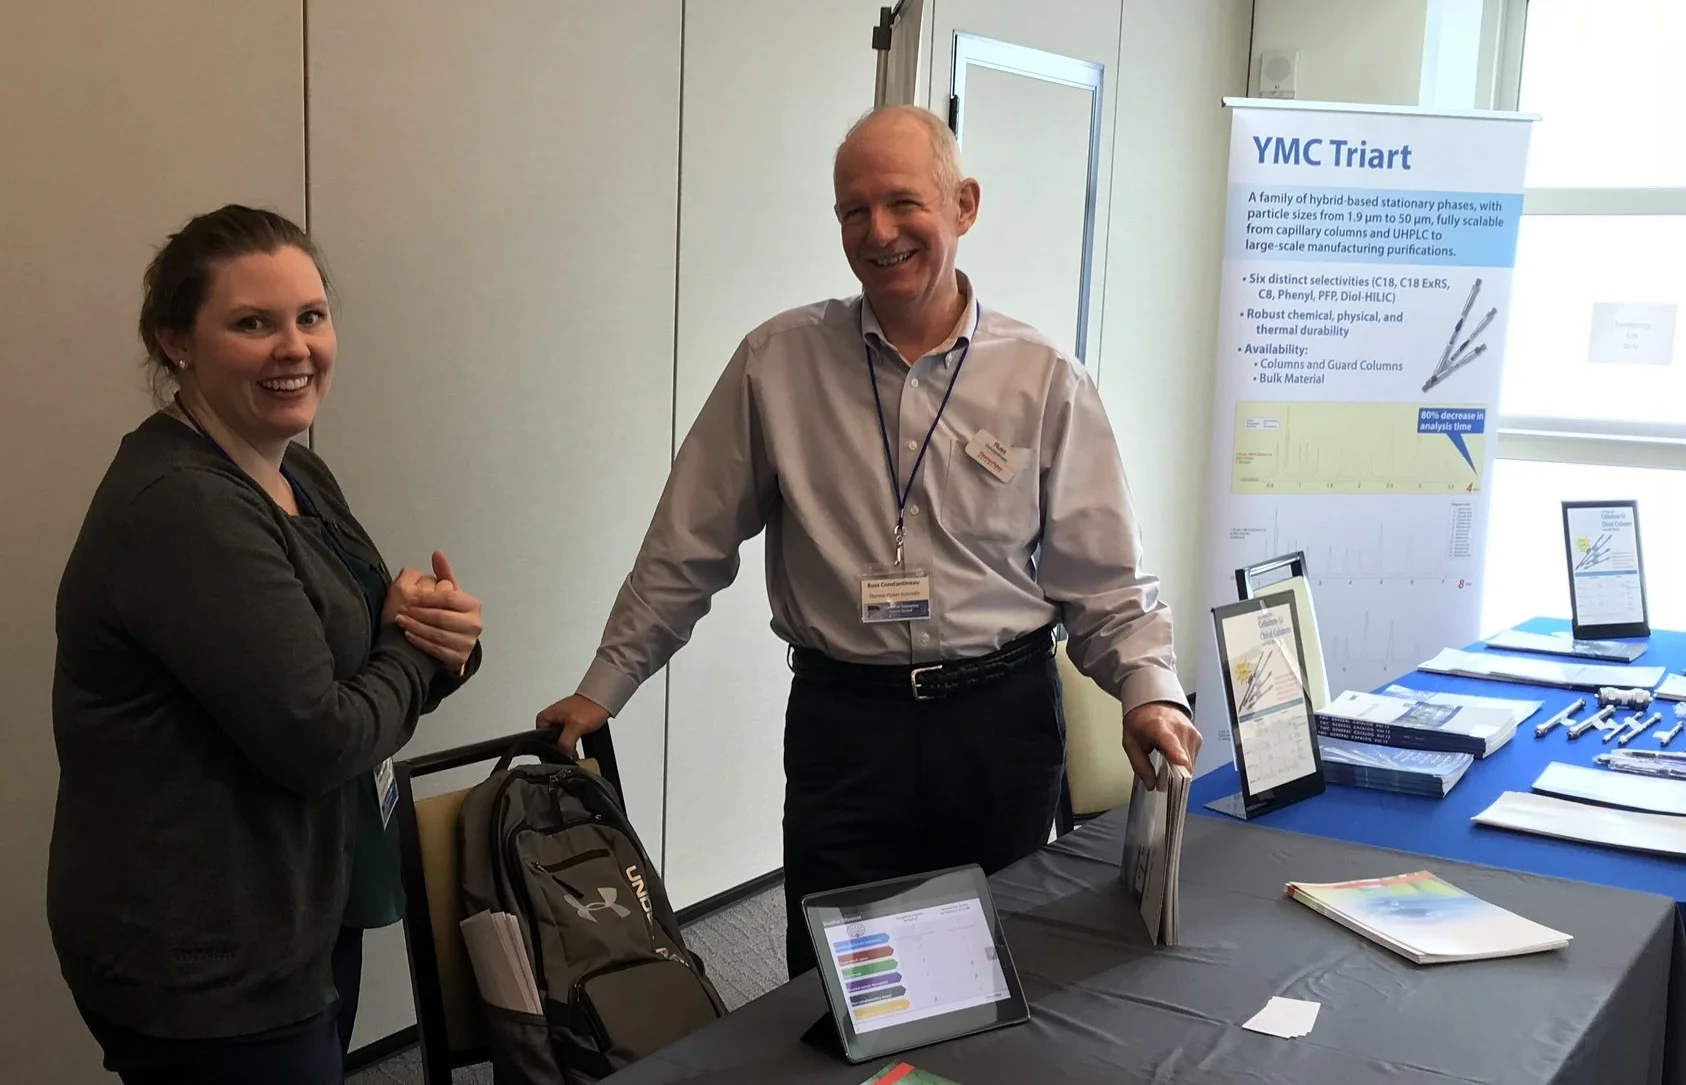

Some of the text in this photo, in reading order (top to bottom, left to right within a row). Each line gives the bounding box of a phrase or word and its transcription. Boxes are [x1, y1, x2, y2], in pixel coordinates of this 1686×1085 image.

[1253, 136, 1412, 170] YMC Triart
[1248, 191, 1502, 212] A family of hybrid-based stationary phases, with
[1247, 208, 1290, 220] particle
[1292, 209, 1318, 220] sizes
[1320, 209, 1345, 221] from
[1347, 211, 1363, 222] 1.9
[1385, 214, 1396, 223] to
[1398, 213, 1412, 224] 50
[1436, 214, 1460, 228] fully
[1462, 216, 1504, 227] scalable
[1246, 223, 1442, 241] from capillary columns and UHPLC to
[1245, 238, 1457, 257] large-scale manufacturing purifications.
[1249, 272, 1450, 290] Six distinct selectivities (C18, C18 ExRS,
[1258, 288, 1396, 304] C8, Phenyl, PFP, Diol-HILIC)
[1247, 308, 1403, 323] Robust chemical, physical, and
[1256, 323, 1349, 338] thermal durability
[1244, 343, 1308, 357] Availability:
[1260, 358, 1403, 371] Columns and Guard Columns
[1259, 373, 1325, 384] Bulk Material
[1420, 410, 1484, 420] 80% decrease in
[1420, 421, 1472, 432] analysis time
[1466, 482, 1473, 493] 4
[1458, 579, 1465, 589] 8
